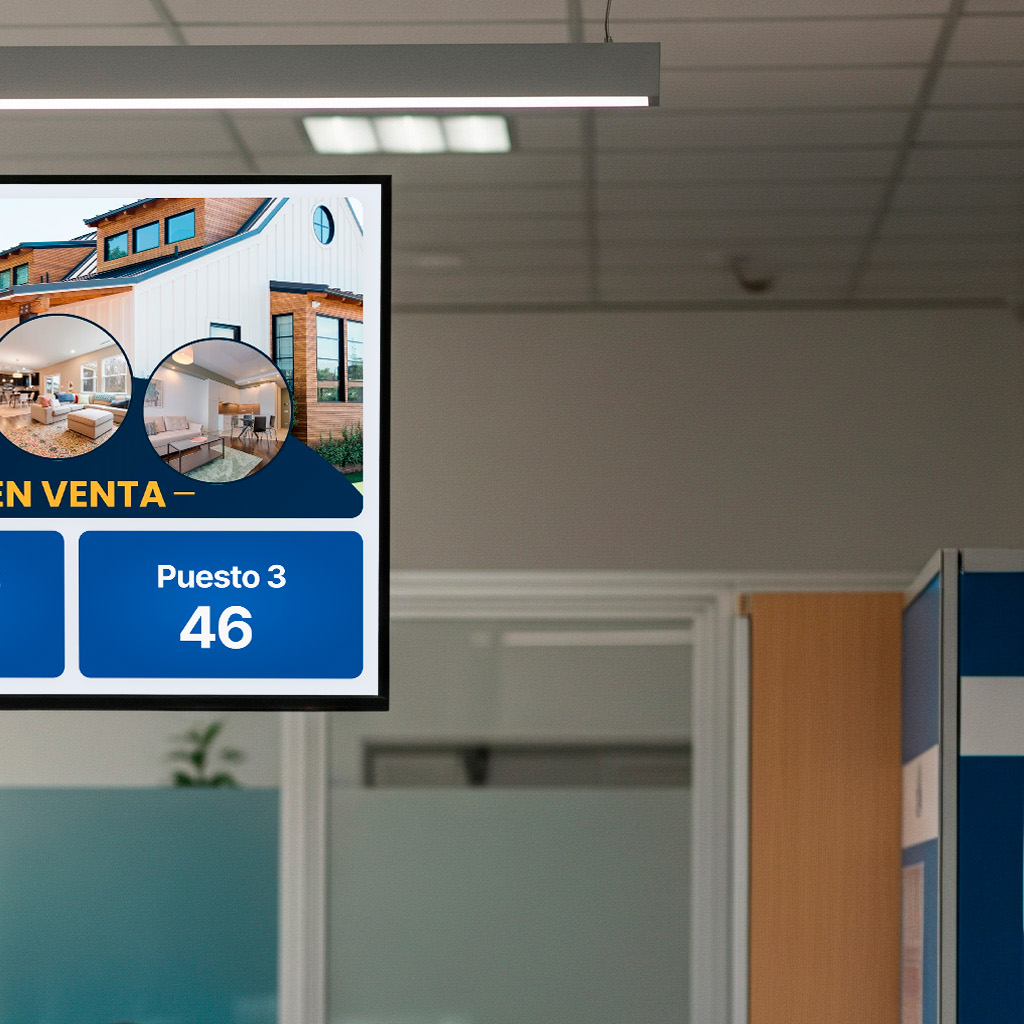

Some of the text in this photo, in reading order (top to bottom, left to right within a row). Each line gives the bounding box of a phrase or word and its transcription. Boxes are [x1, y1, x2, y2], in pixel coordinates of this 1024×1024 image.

[41, 481, 166, 507] VENTA
[158, 565, 286, 588] Puesto 3
[180, 606, 252, 649] 46
